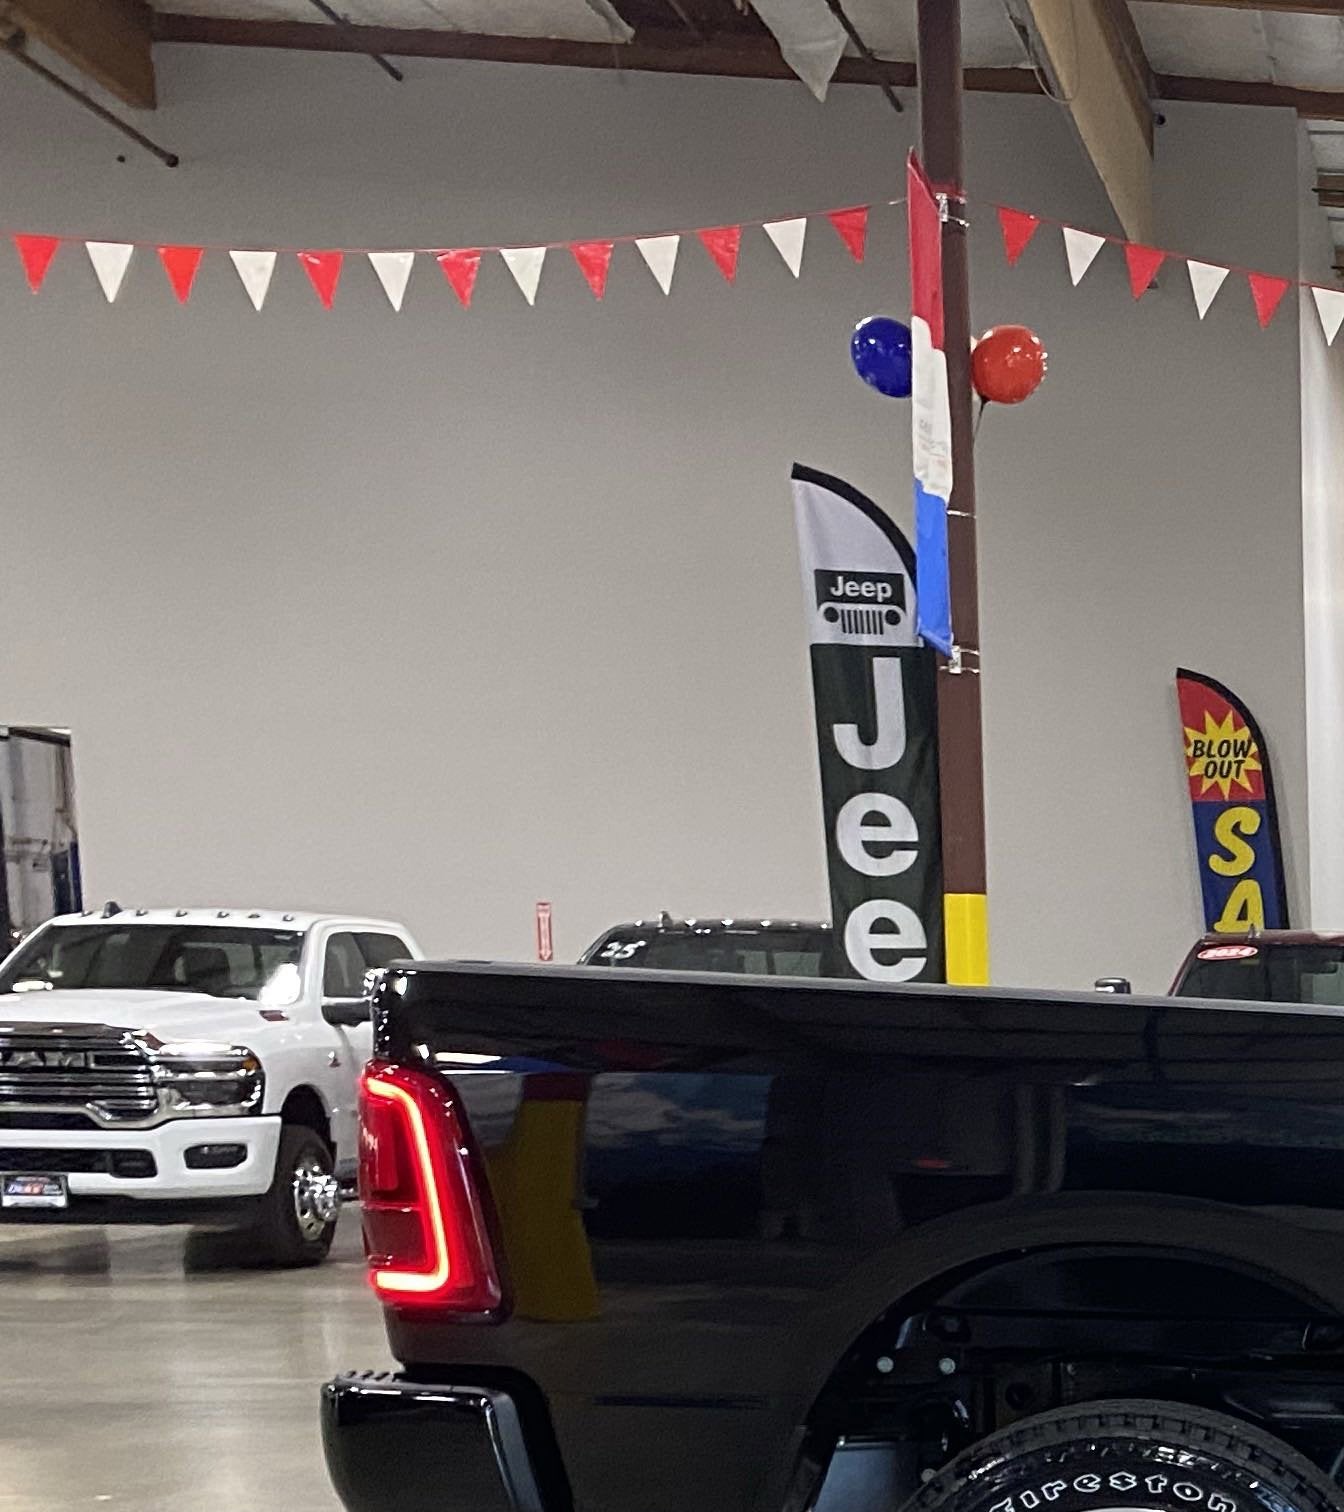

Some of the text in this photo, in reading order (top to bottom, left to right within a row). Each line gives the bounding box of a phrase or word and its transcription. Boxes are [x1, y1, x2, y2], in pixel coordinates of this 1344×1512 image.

[830, 576, 892, 602] Jeep
[1193, 739, 1250, 758] BLOW
[1204, 759, 1246, 779] OUT
[832, 656, 928, 982] Jee
[1208, 806, 1266, 933] SA
